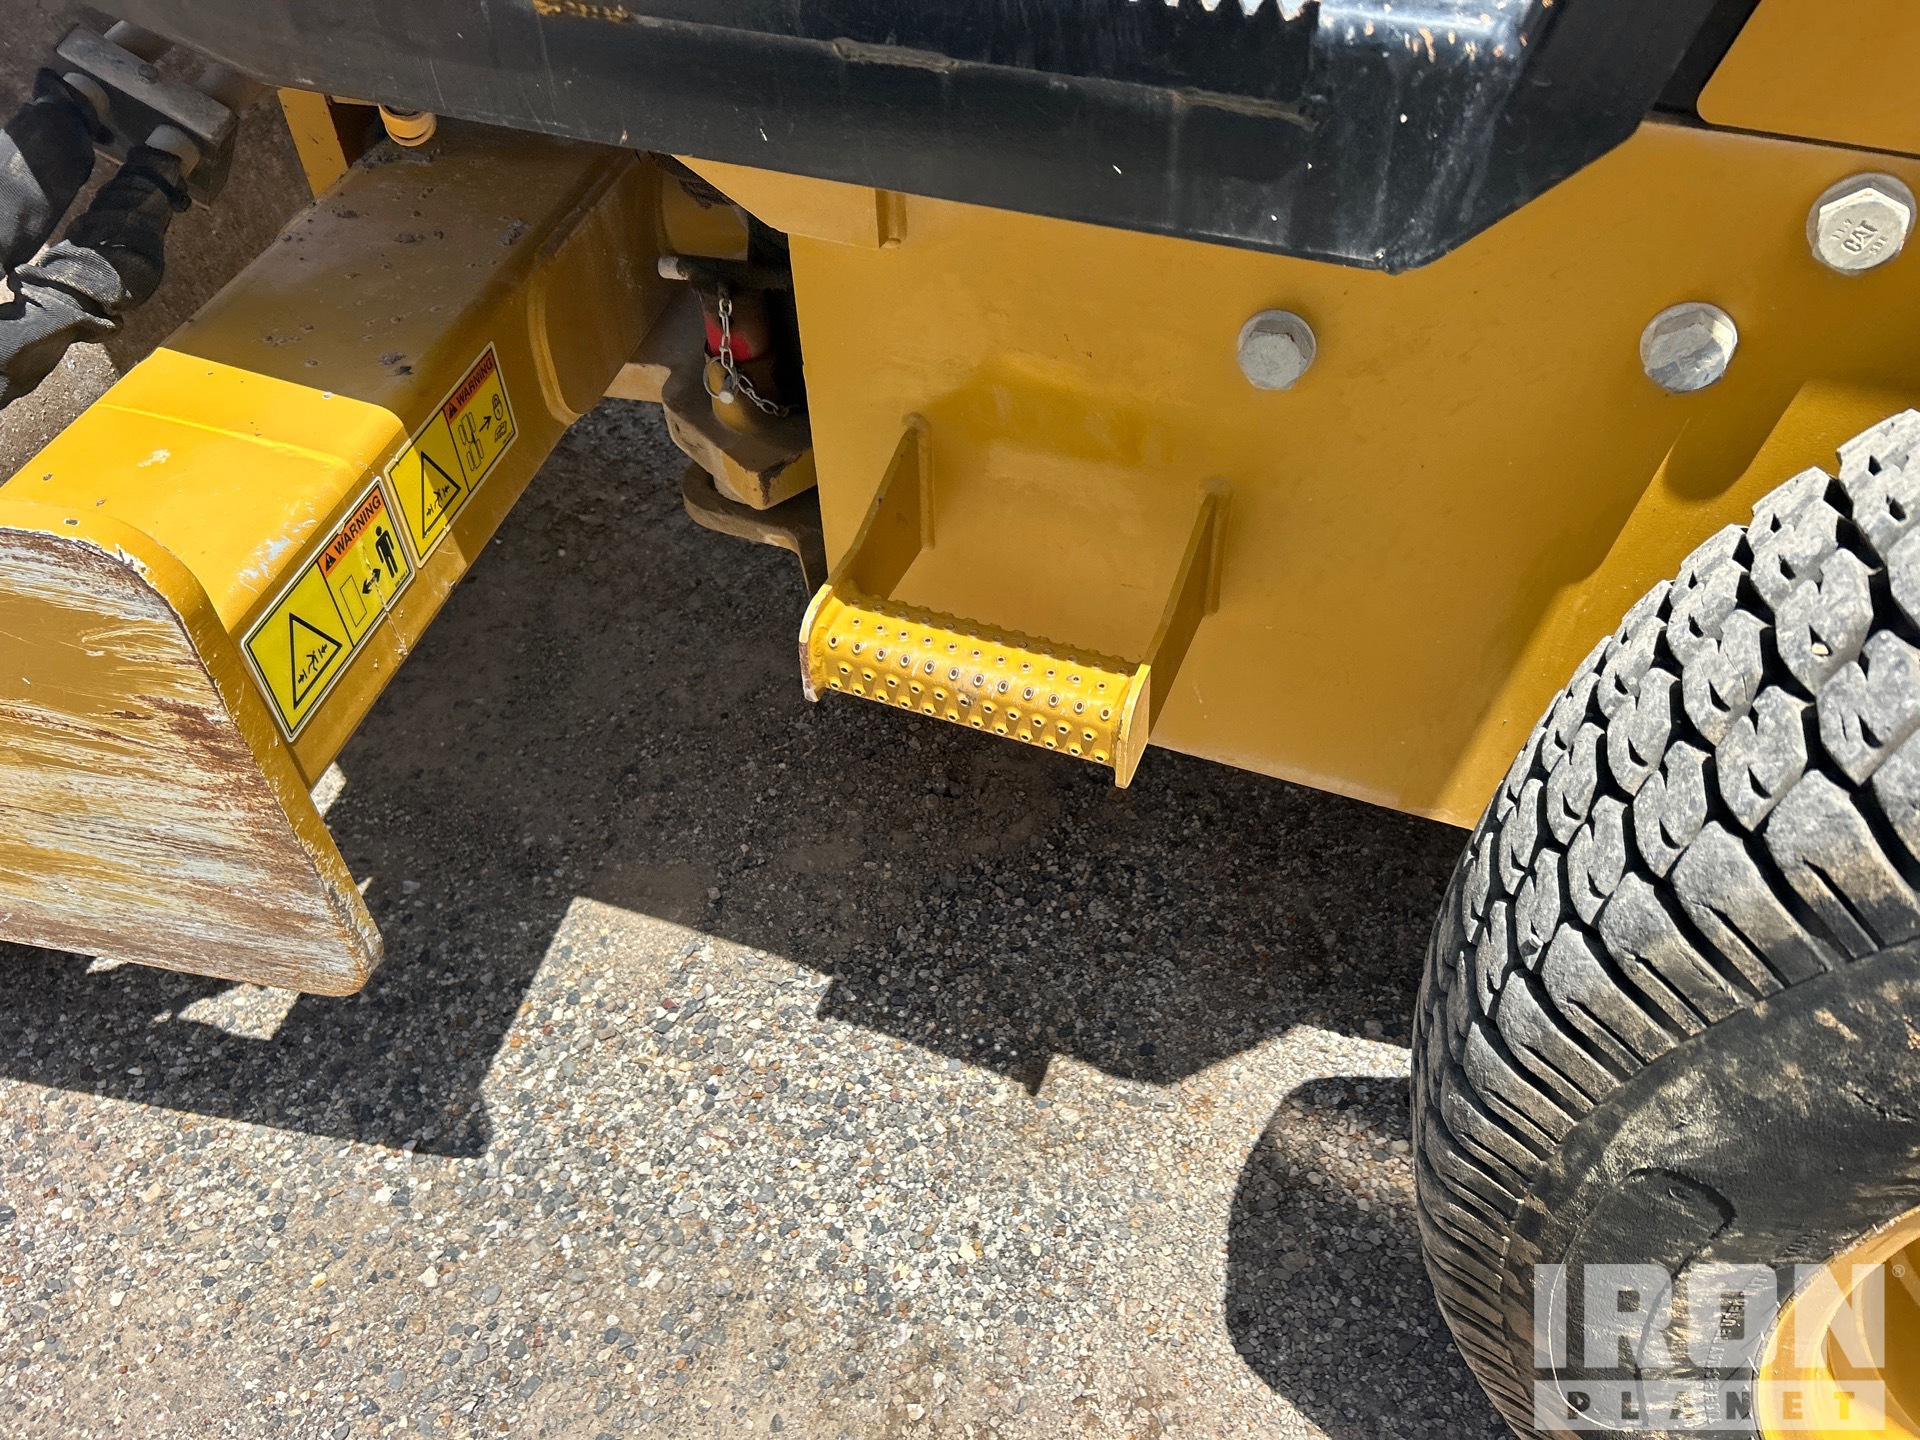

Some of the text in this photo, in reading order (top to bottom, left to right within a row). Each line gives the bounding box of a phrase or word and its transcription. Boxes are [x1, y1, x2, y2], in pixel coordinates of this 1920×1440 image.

[1841, 220, 1878, 255] CAT
[455, 357, 494, 406] WARNING
[333, 495, 382, 555] WARNING
